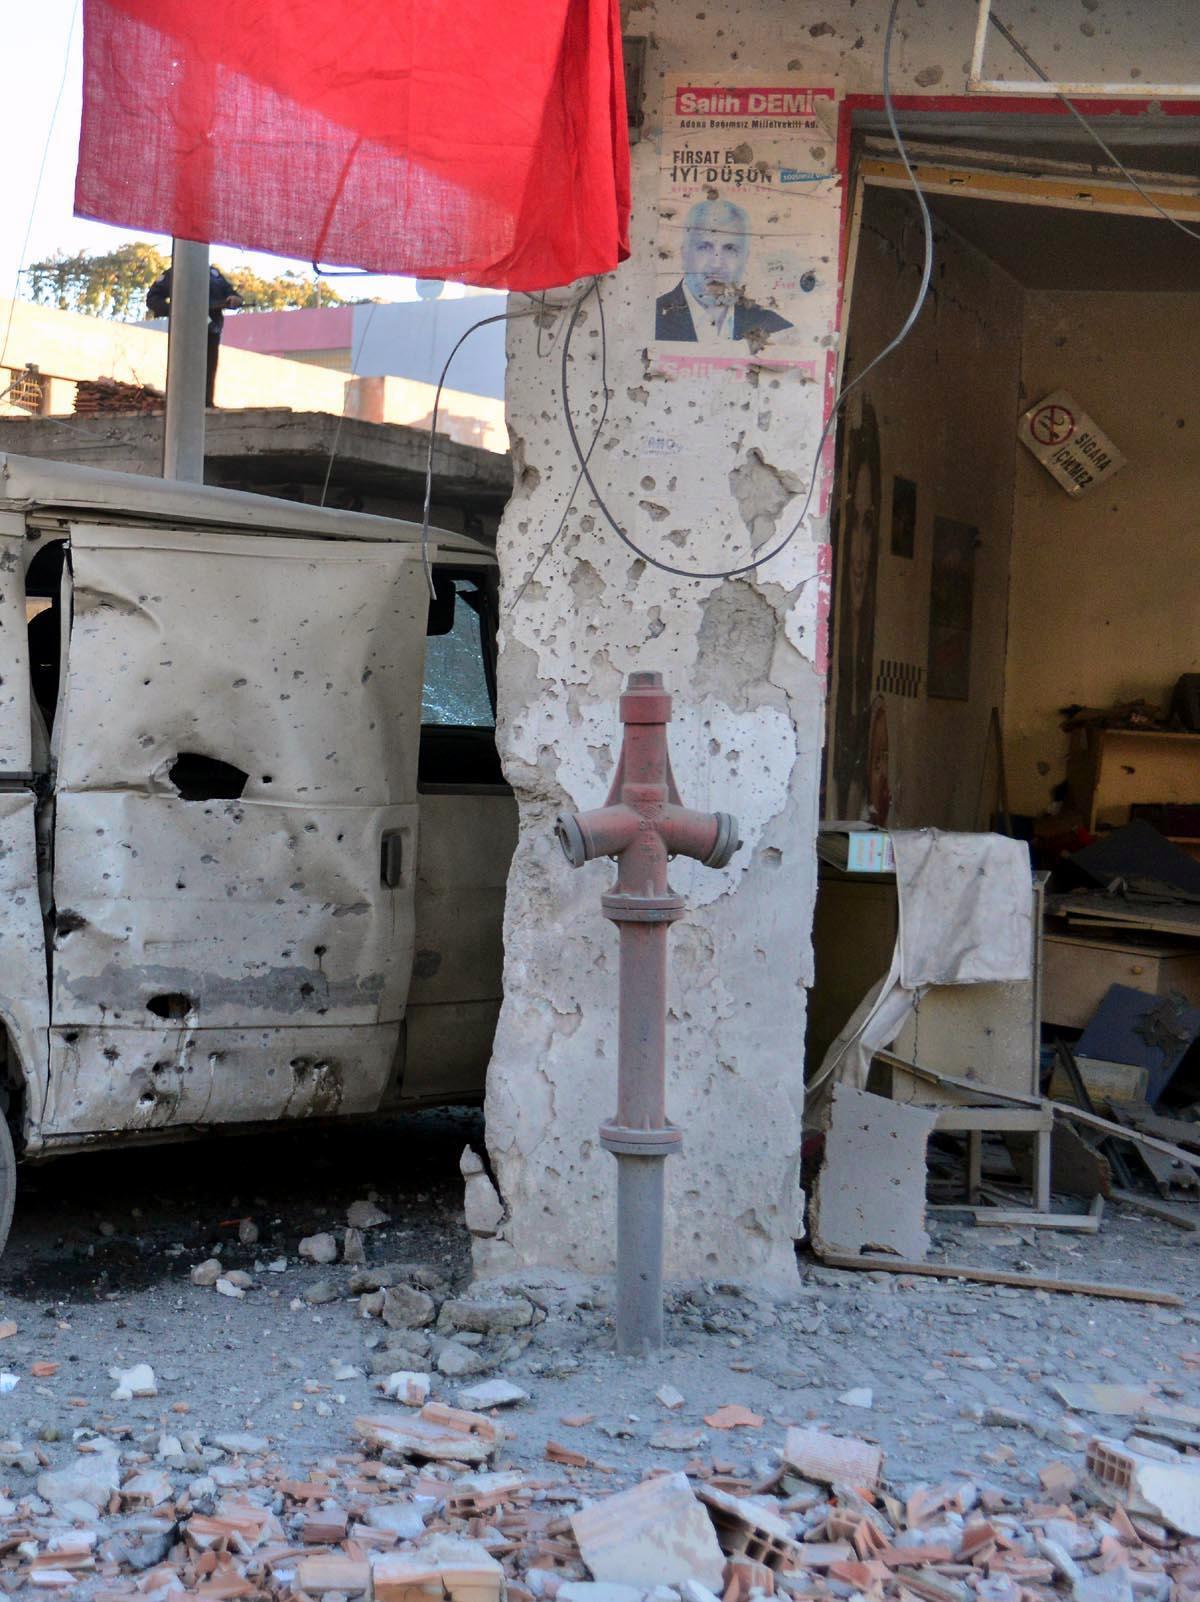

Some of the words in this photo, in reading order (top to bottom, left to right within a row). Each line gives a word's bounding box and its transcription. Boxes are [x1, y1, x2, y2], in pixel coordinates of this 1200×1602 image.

[679, 92, 740, 113] Salih
[673, 150, 720, 164] FIRSAT
[672, 164, 698, 182] İYİ
[706, 164, 772, 187] DÜŞÜN
[1075, 432, 1112, 473] SİGARA
